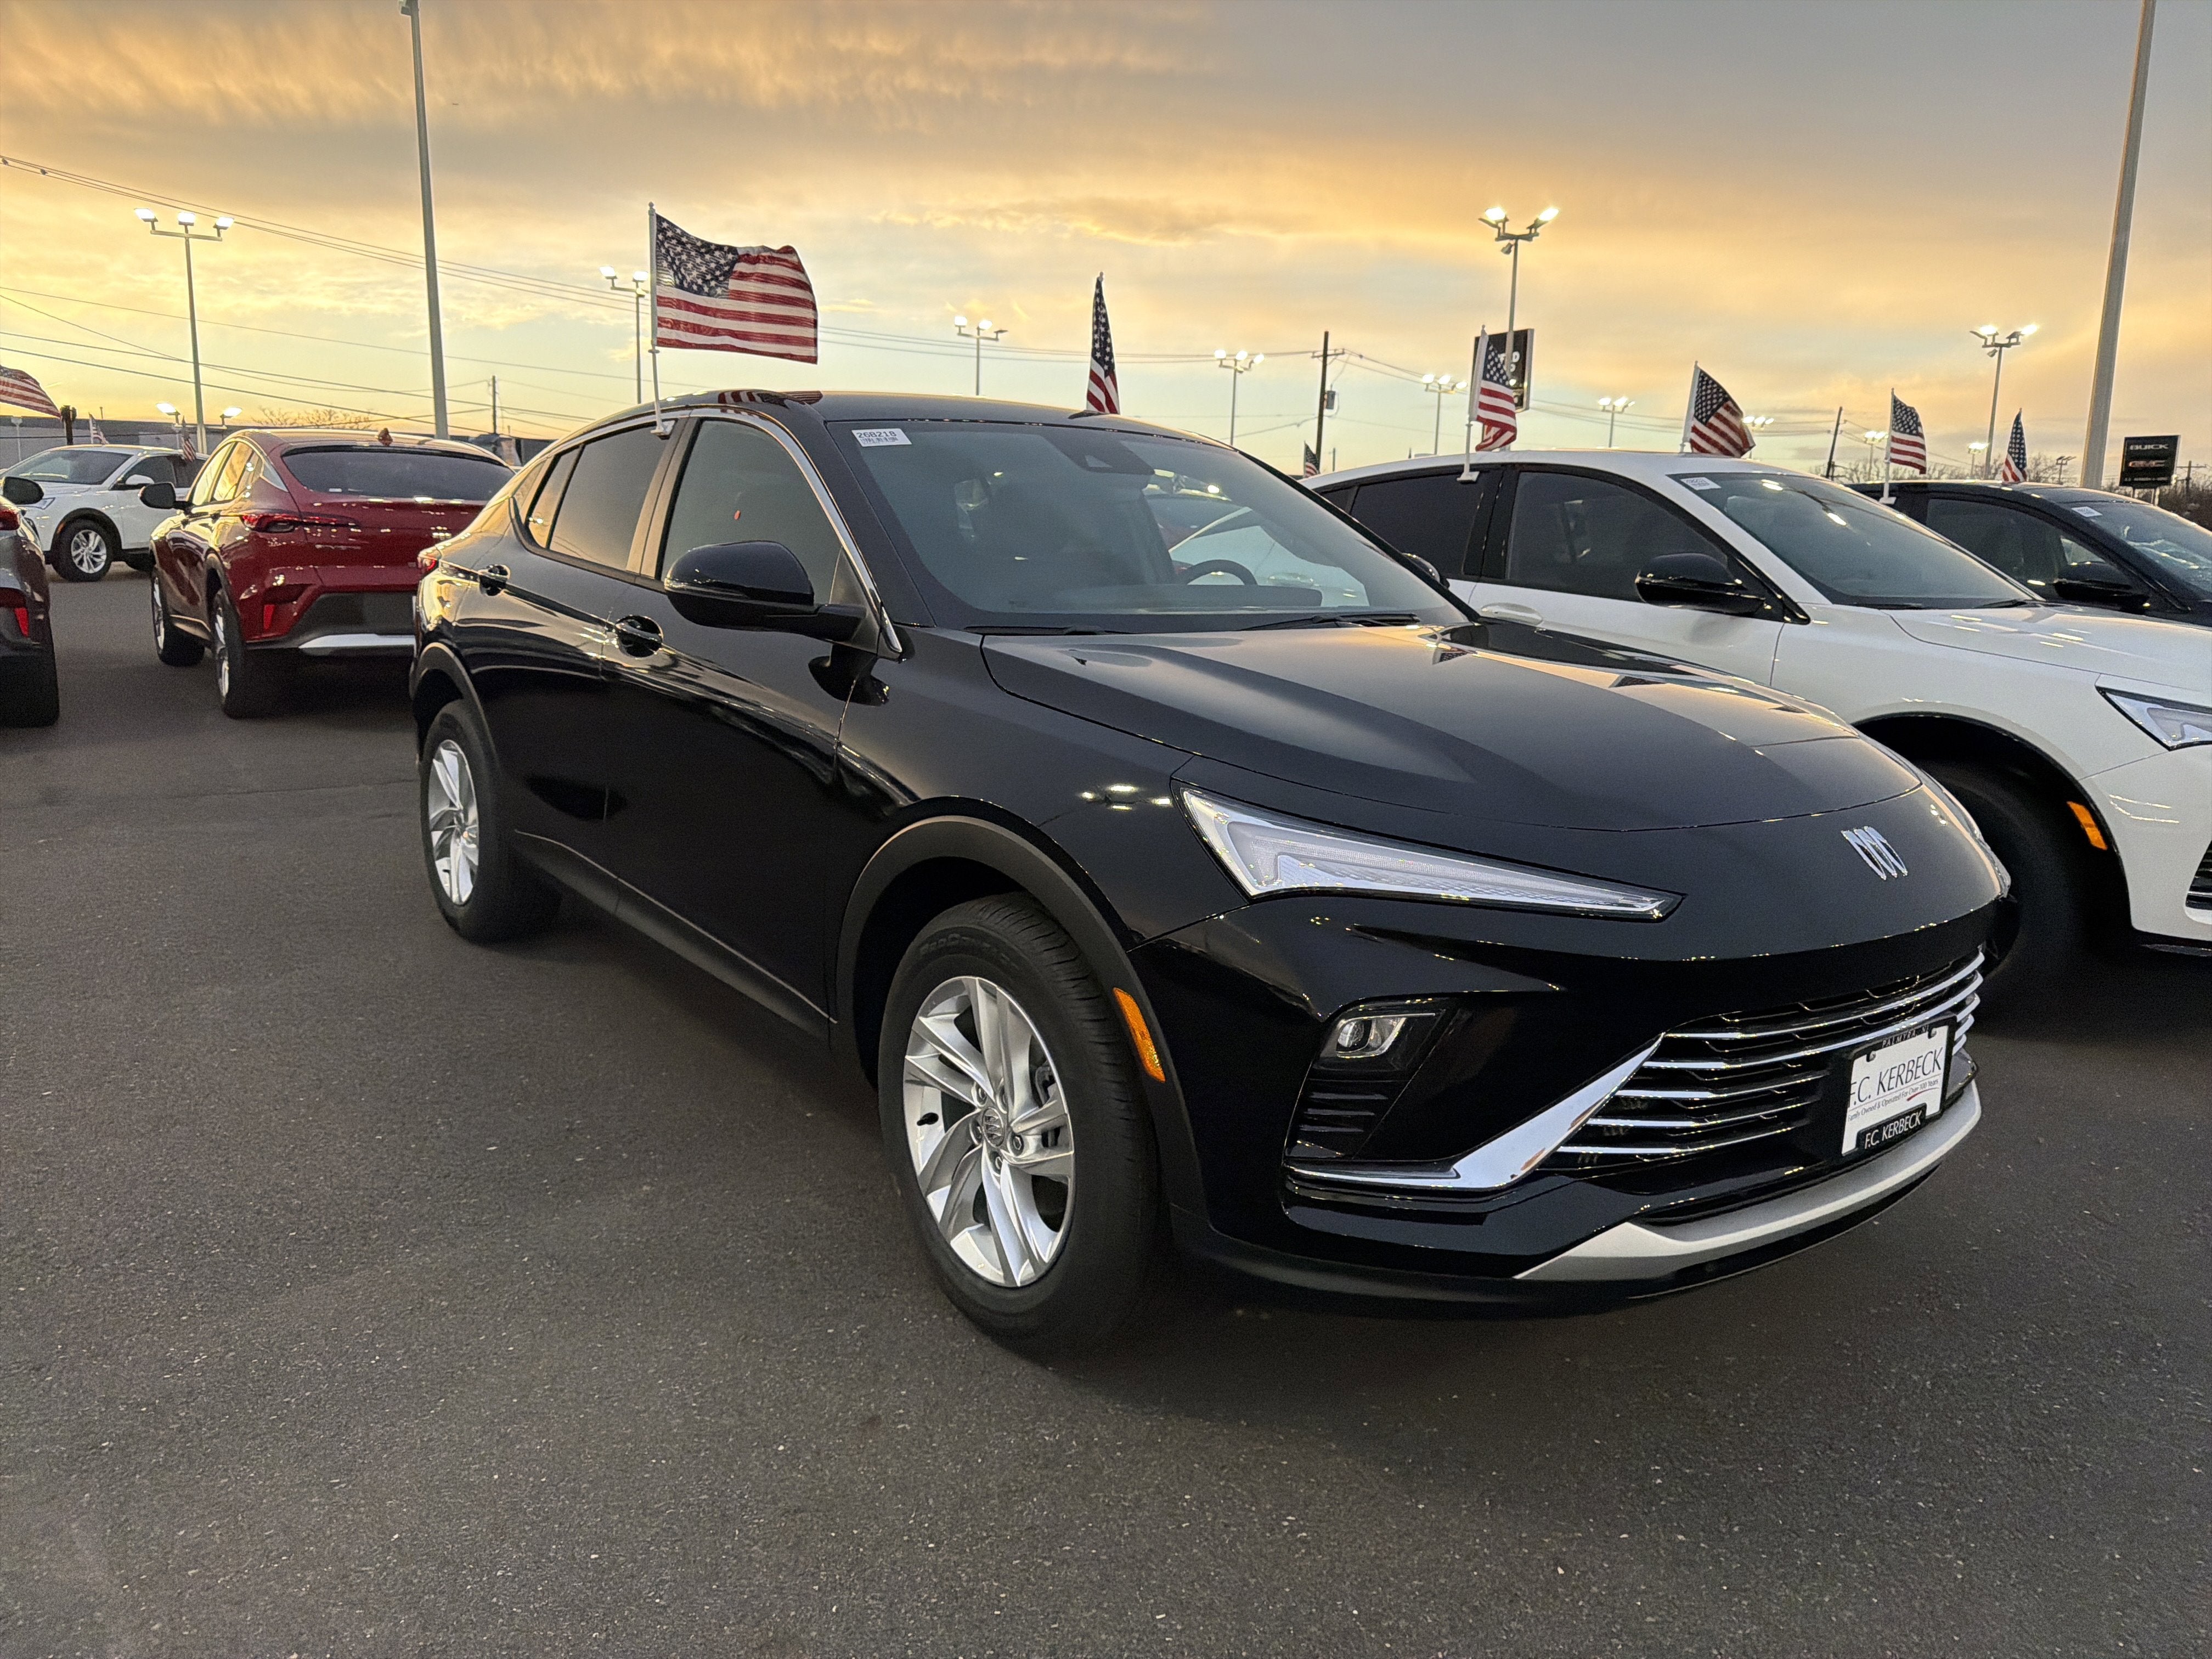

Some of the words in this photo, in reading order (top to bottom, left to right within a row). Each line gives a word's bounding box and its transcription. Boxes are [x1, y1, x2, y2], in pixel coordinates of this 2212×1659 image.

[1877, 1047, 1943, 1095] KERBECK
[1865, 1130, 1880, 1149] F.C.
[1882, 1110, 1922, 1141] KERBECK
